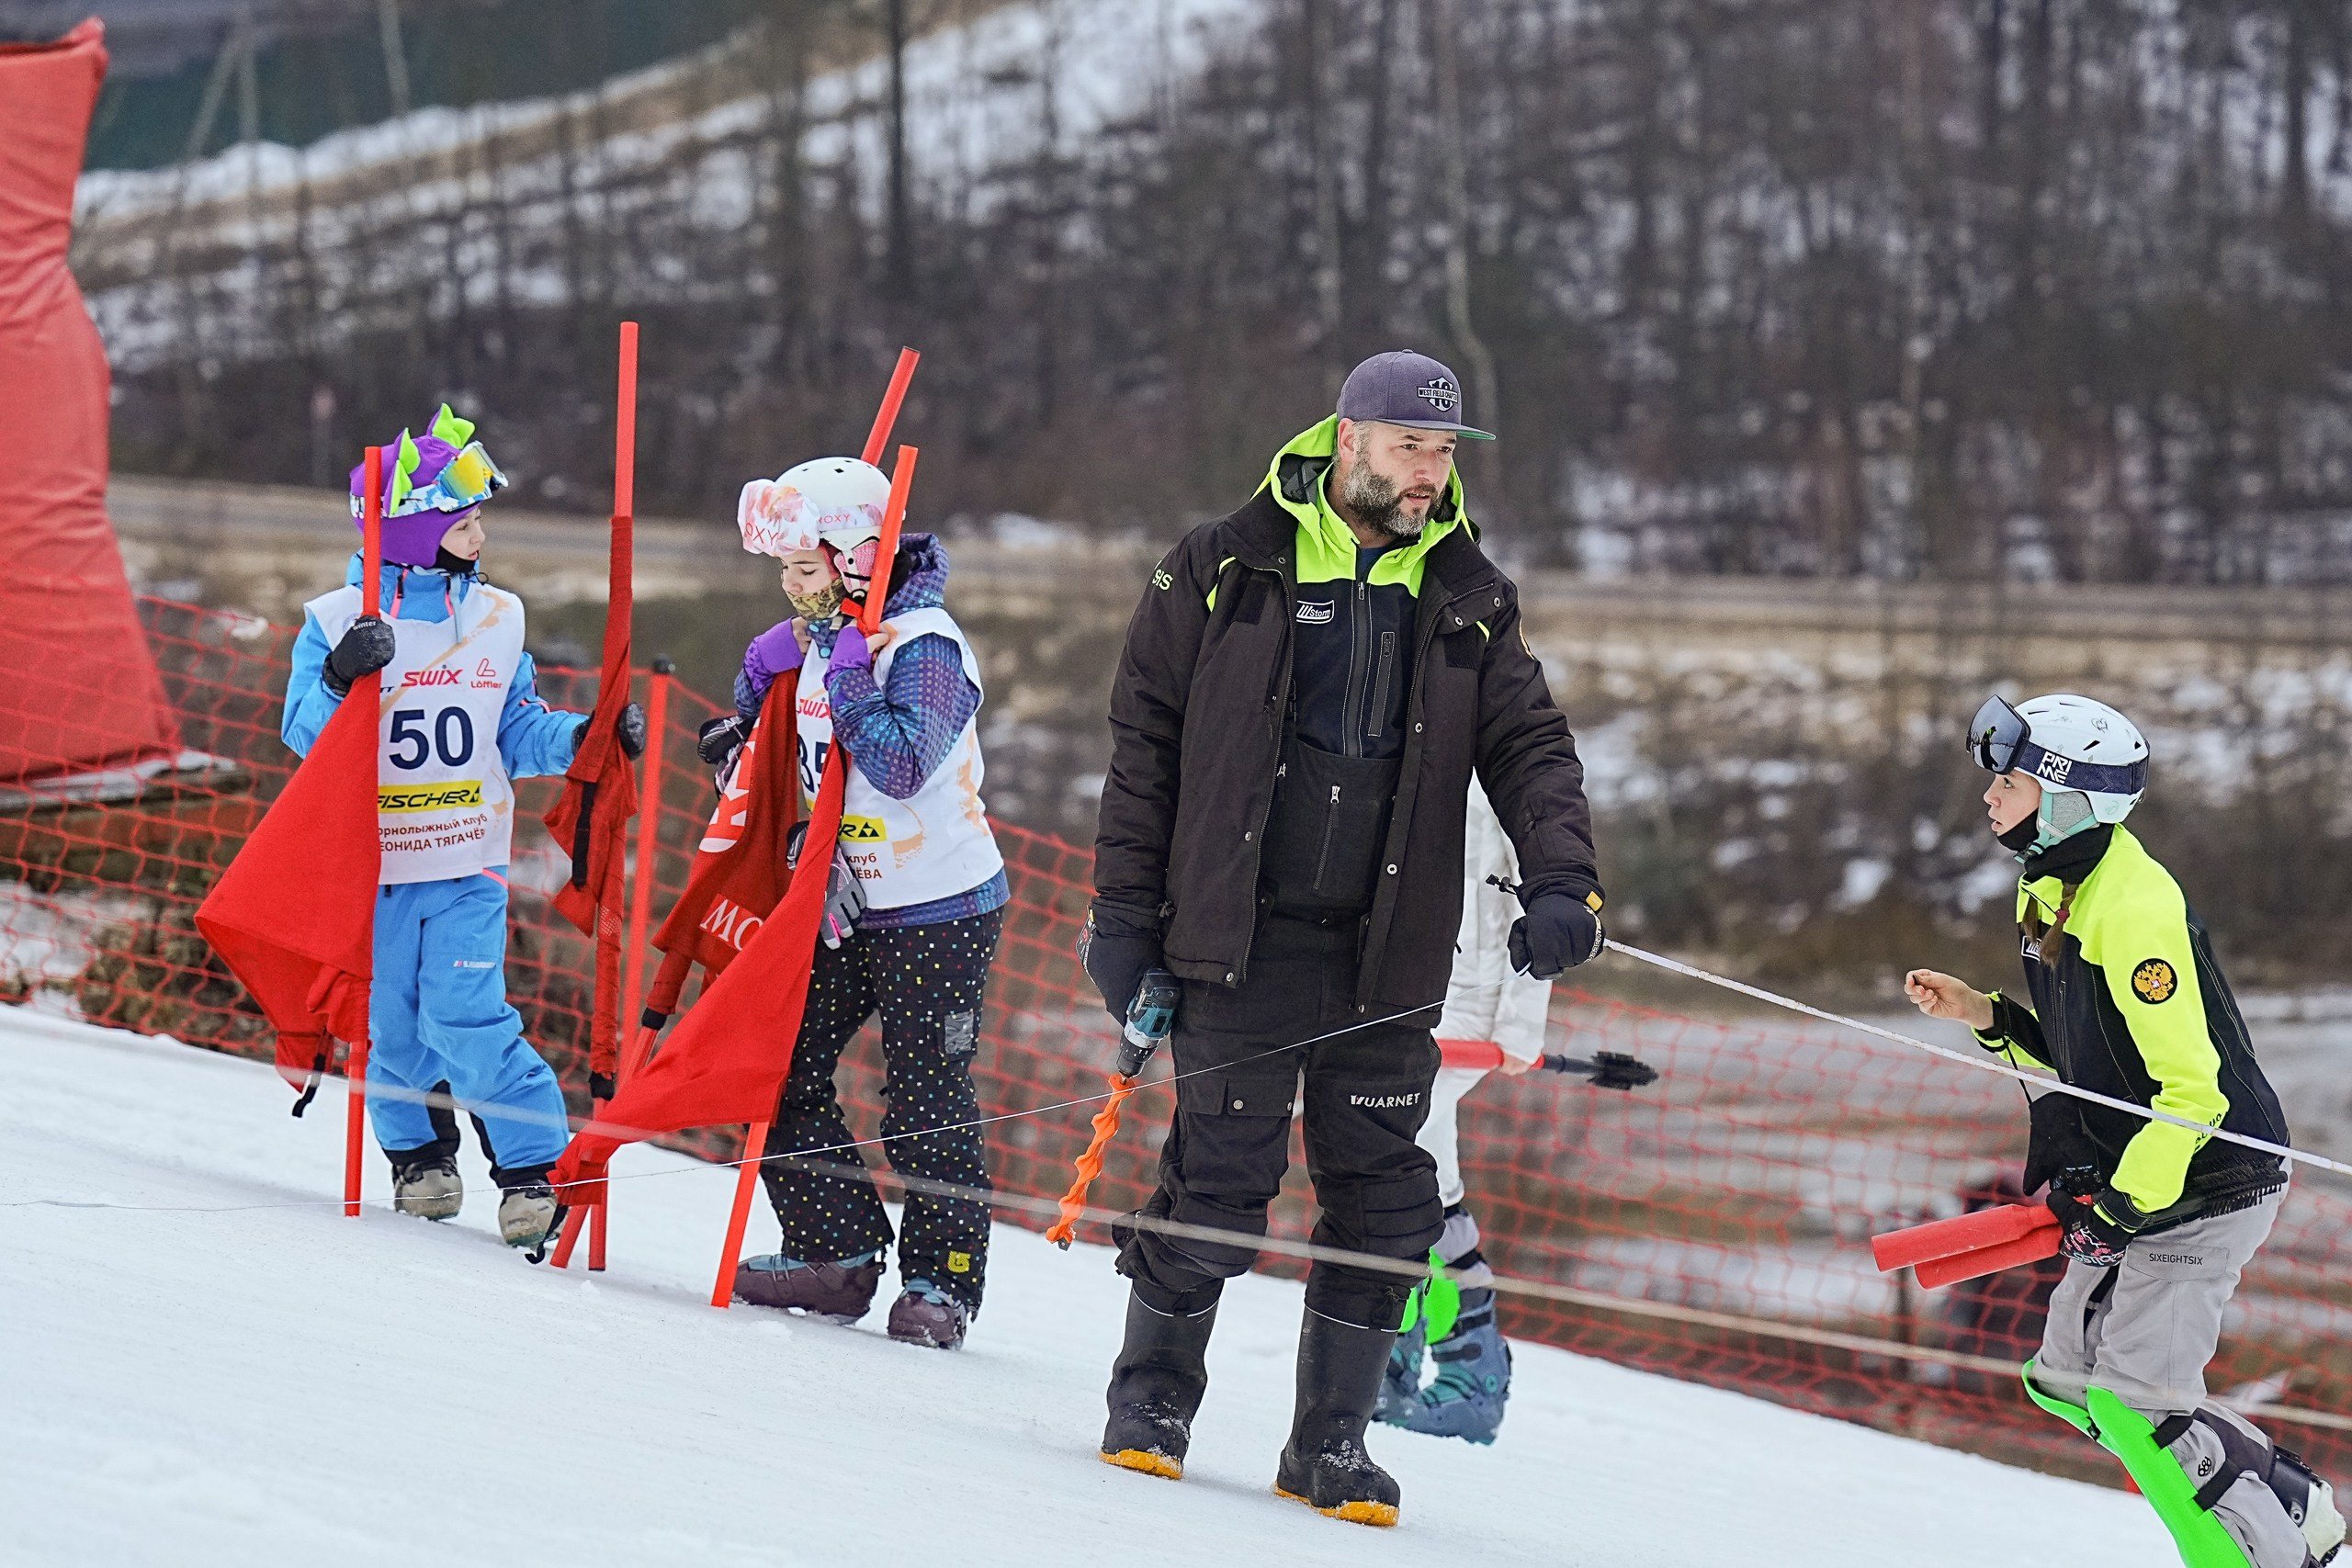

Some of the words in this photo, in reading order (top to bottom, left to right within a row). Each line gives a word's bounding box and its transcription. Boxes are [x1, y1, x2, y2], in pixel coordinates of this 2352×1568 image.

[745, 523, 779, 547] OXY
[470, 680, 503, 689] Löffler
[389, 705, 474, 770] 50
[378, 819, 460, 838] орнолыжный
[462, 813, 488, 826] клуб
[379, 838, 432, 852] ЕОНИДА
[2148, 1252, 2203, 1266] SIXEIGHTSIX
